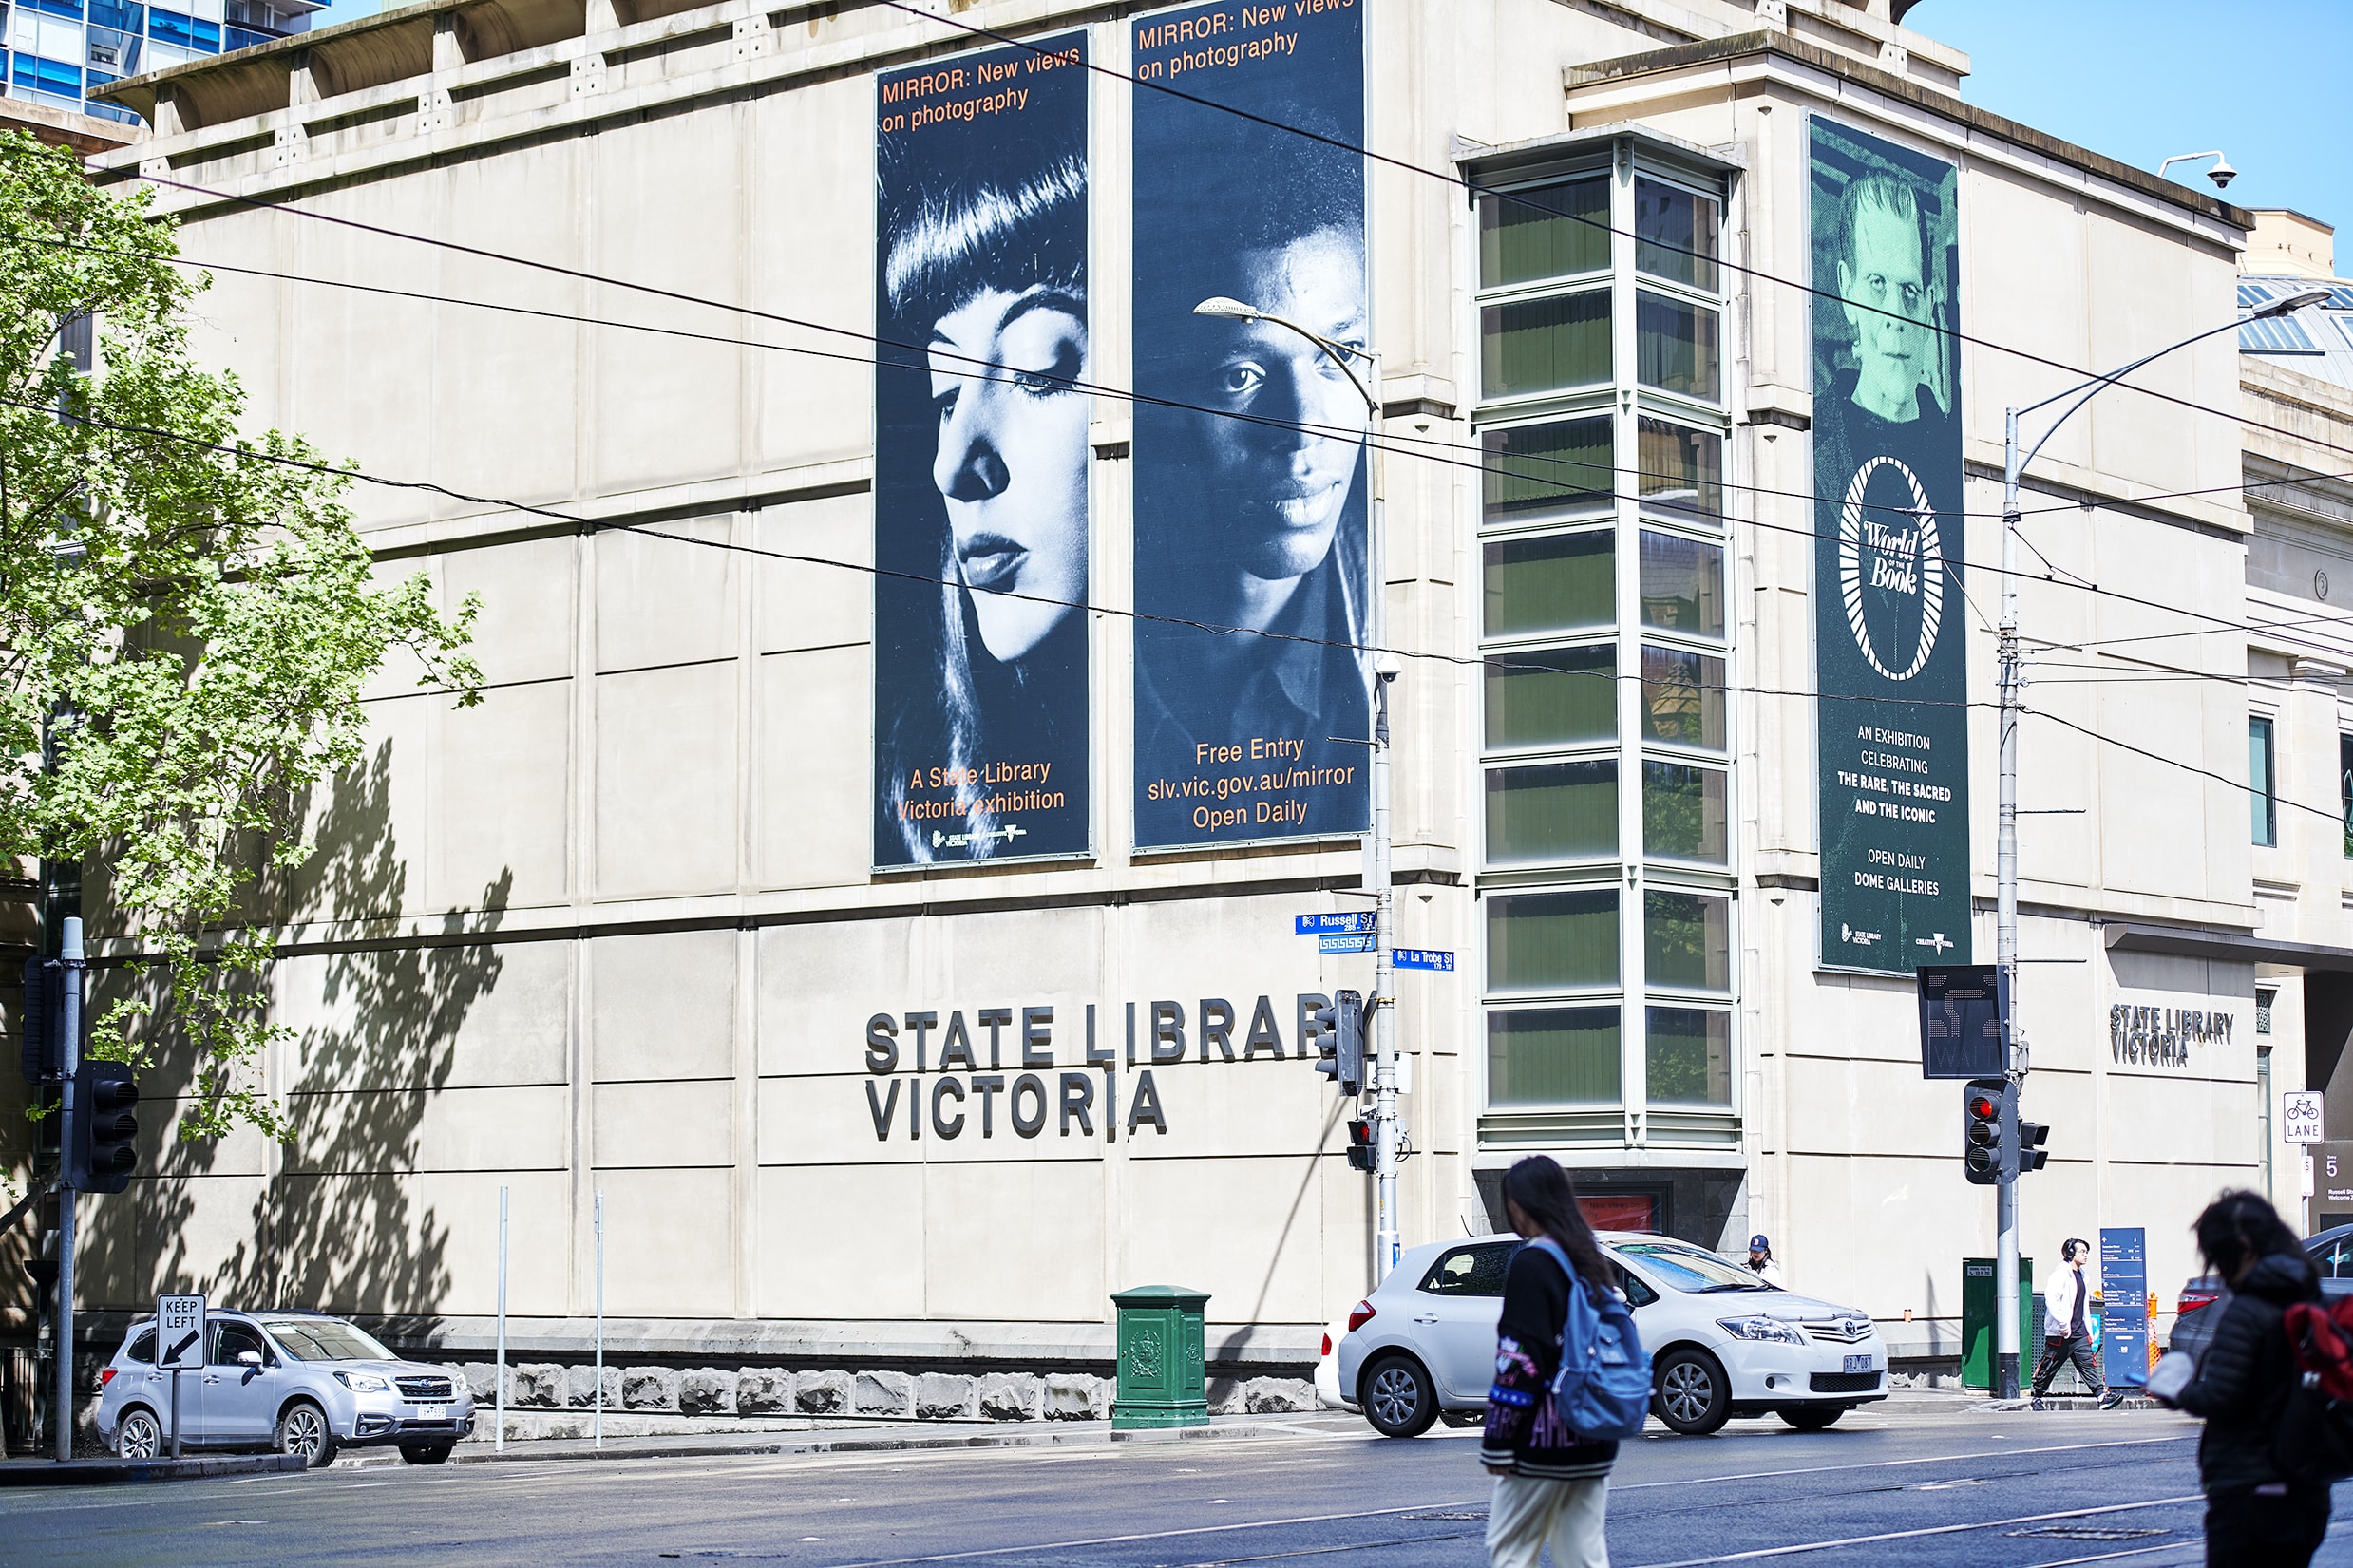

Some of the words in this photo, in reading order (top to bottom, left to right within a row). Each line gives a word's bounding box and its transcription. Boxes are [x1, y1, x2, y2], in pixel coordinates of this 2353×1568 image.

[1138, 13, 1235, 50] MIRROR:
[1243, 5, 1287, 28] New
[1138, 61, 1163, 81] on
[1169, 31, 1298, 79] photography
[882, 69, 972, 104] MIRROR:
[977, 62, 1019, 85] New
[1025, 47, 1081, 74] views
[882, 112, 905, 134] on
[911, 86, 1030, 131] photography
[1863, 520, 1920, 561] World
[1869, 556, 1918, 595] Book
[1196, 743, 1243, 764] Free
[1251, 737, 1304, 761] Entry
[1857, 725, 1873, 741] AN
[1875, 728, 1931, 750] EXHIBITION
[910, 769, 924, 789] A
[929, 765, 978, 788] State
[985, 761, 1052, 784] Library
[1861, 749, 1929, 775] CELEBRATING
[1148, 765, 1356, 801] slv.vic.gov.au/mirror
[1838, 770, 1858, 787] THE
[1860, 774, 1890, 796] RARE,
[1891, 780, 1912, 797] THE
[1913, 784, 1952, 803] SACRED
[896, 796, 967, 821] Victoria
[973, 789, 1065, 815] exhibition
[1192, 806, 1248, 832] Open
[1256, 799, 1308, 825] Daily
[1855, 798, 1877, 815] AND
[1879, 802, 1899, 820] THE
[1901, 804, 1936, 824] ICONIC
[1868, 848, 1895, 866] OPEN
[1898, 853, 1926, 870] DAILY
[1854, 871, 1885, 890] DOME
[1887, 876, 1940, 897] GALLERIES
[1320, 914, 1357, 926] Russell
[1360, 913, 1373, 924] St
[1411, 951, 1420, 962] La
[1421, 952, 1442, 964] Trobe
[1444, 953, 1453, 964] St
[2110, 1003, 2161, 1030] STATE
[2166, 1008, 2234, 1036] LIBRARY
[865, 1006, 1053, 1075] STATE
[2111, 1031, 2189, 1059] VICTORIA
[1934, 1045, 1993, 1067] WAIT
[865, 1069, 1167, 1143] VICTORIA
[2287, 1125, 2319, 1137] LANE
[2326, 1160, 2338, 1178] 5
[166, 1301, 198, 1313] KEEP
[166, 1316, 197, 1329] LEFT
